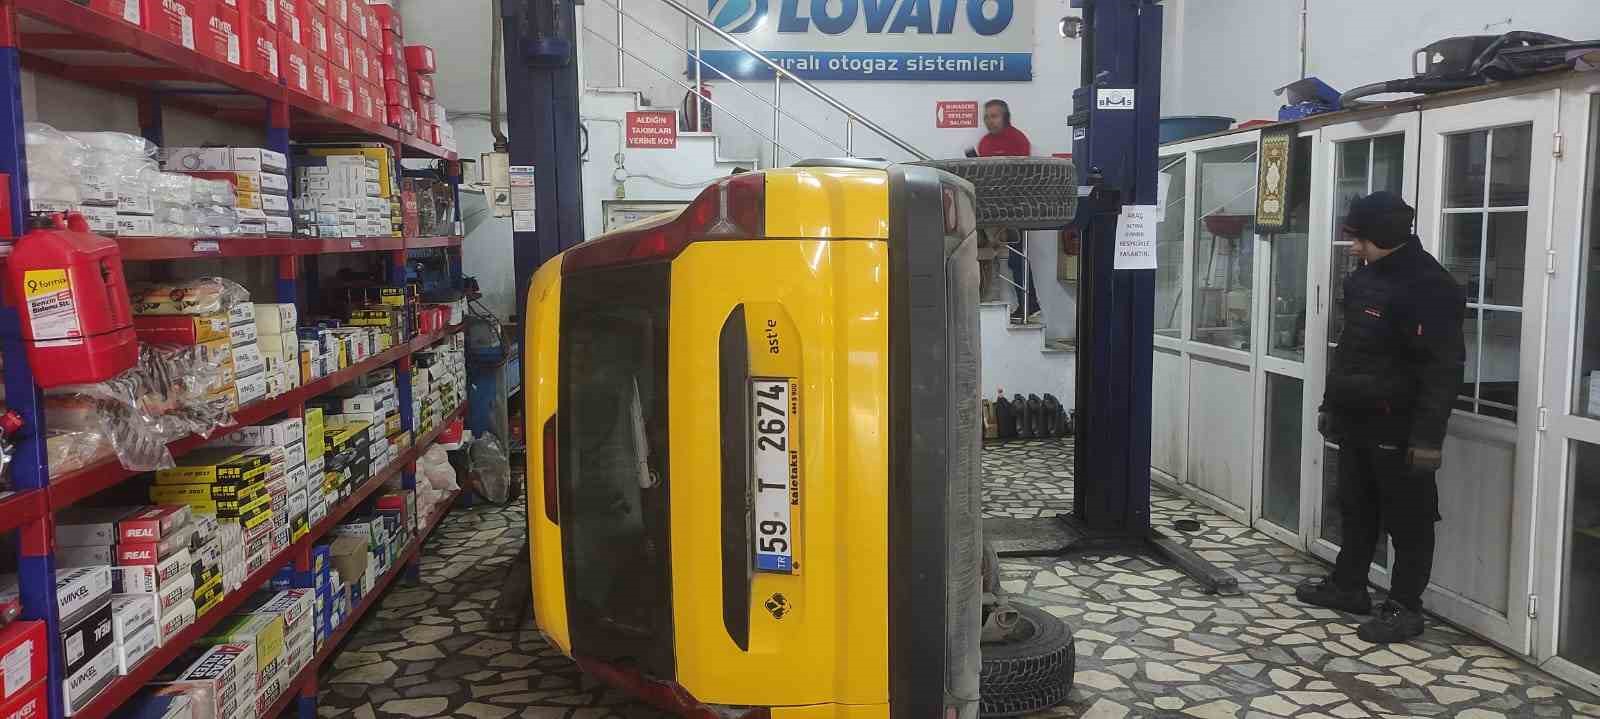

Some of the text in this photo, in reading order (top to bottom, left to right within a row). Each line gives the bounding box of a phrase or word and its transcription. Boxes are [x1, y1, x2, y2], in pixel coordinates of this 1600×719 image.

[828, 56, 898, 74] otogaz
[906, 55, 1004, 71] sistemleri
[636, 116, 667, 124] ALDIĞIN
[628, 136, 657, 144] YERİNE
[631, 127, 672, 135] TAKIMLARI
[756, 384, 788, 553] 59 T 2674
[790, 450, 799, 506] kaletaksi
[777, 555, 786, 569] TR
[59, 585, 89, 607] WINKEL
[70, 664, 97, 690] WINKEL
